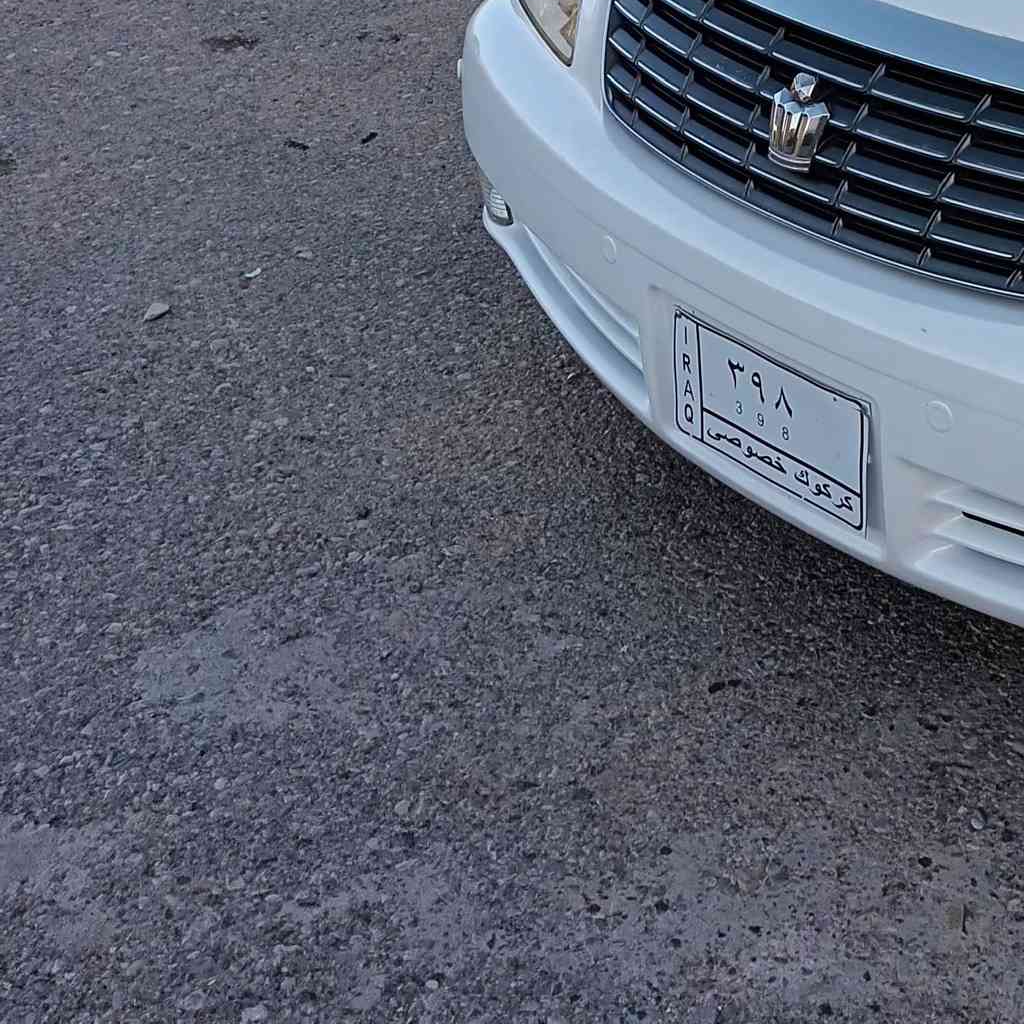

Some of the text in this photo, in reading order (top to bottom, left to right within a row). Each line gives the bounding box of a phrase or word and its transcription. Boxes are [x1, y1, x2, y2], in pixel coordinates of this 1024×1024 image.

[682, 326, 695, 425] IRAQ
[727, 358, 793, 418] ٣٩٨
[735, 400, 790, 441] 398
